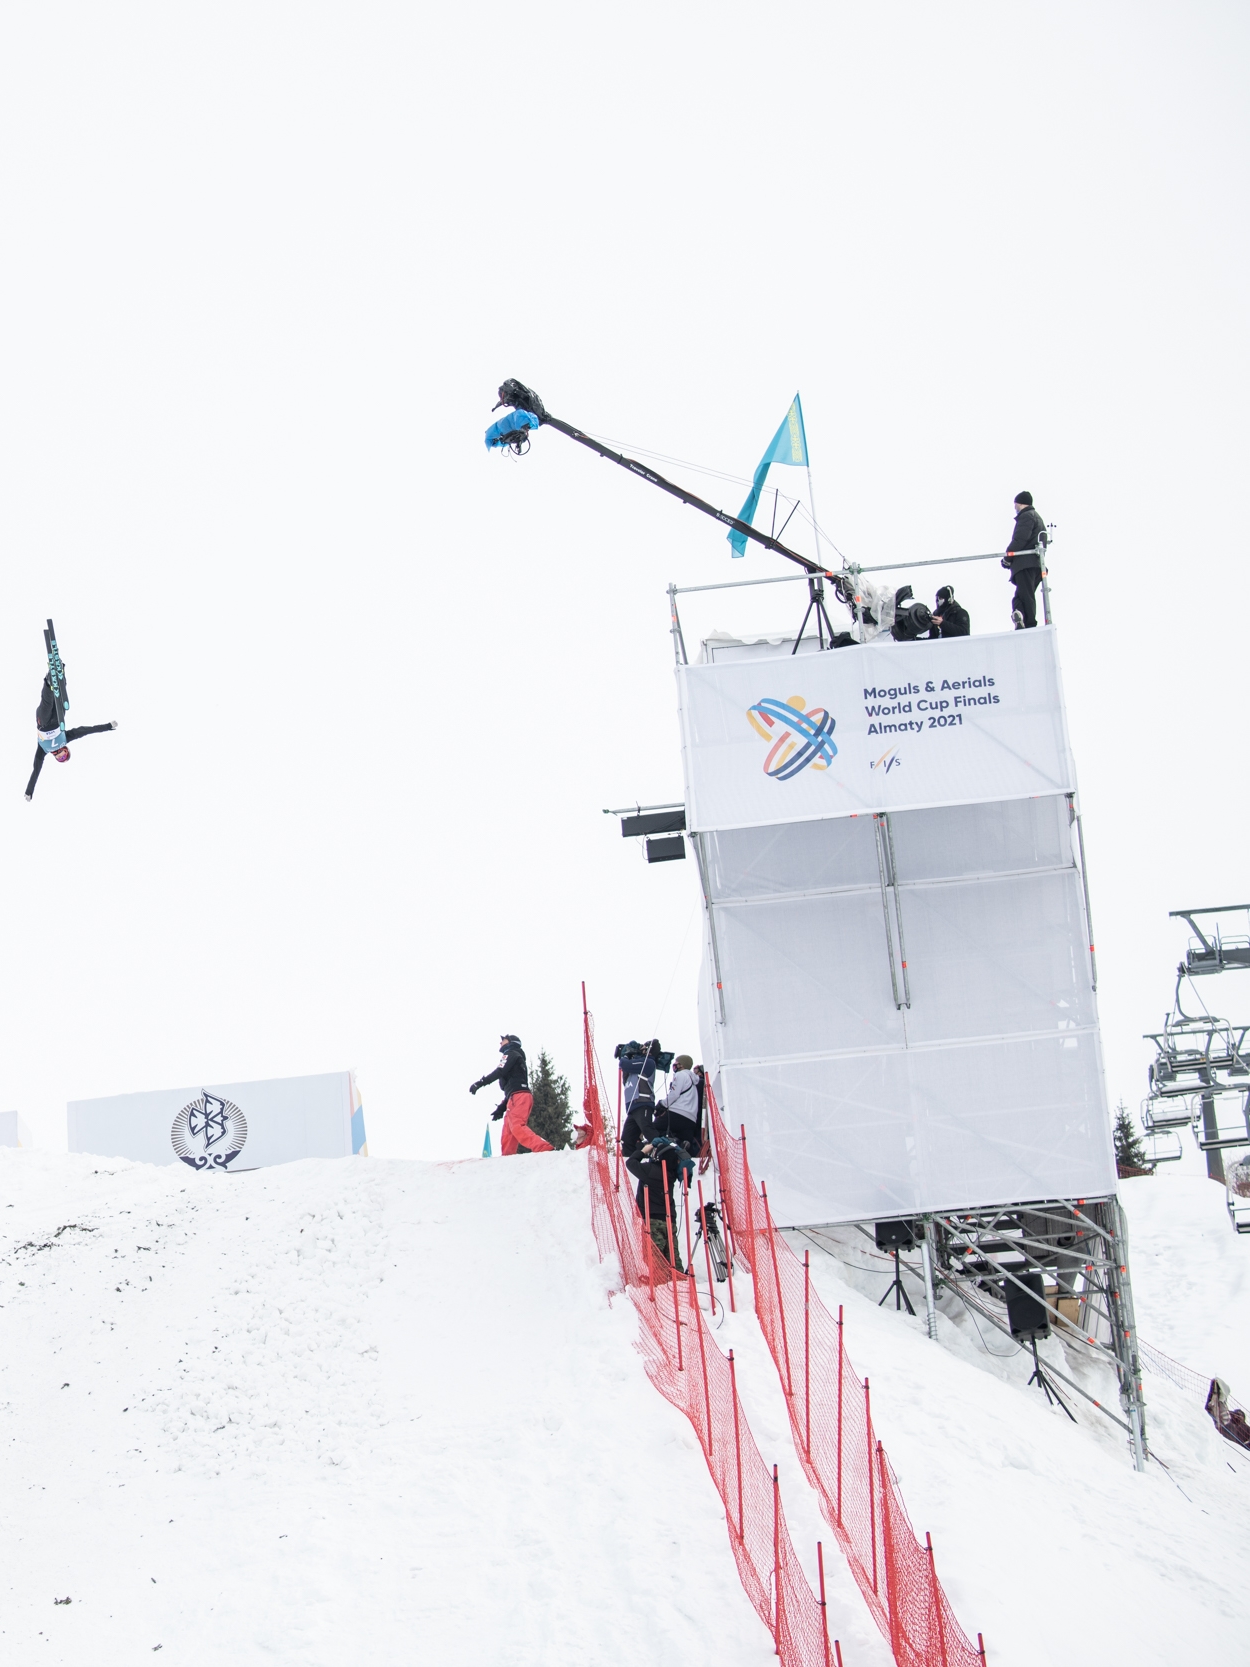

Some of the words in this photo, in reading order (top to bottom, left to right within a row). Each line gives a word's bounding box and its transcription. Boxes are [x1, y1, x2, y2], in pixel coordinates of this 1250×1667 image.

[863, 683, 920, 700] Moguls
[924, 681, 936, 693] &
[940, 675, 995, 691] Aerials
[865, 701, 912, 717] World
[916, 699, 949, 712] Cup
[954, 692, 1000, 708] Finals
[867, 720, 924, 735] Almaty
[928, 713, 963, 729] 2021
